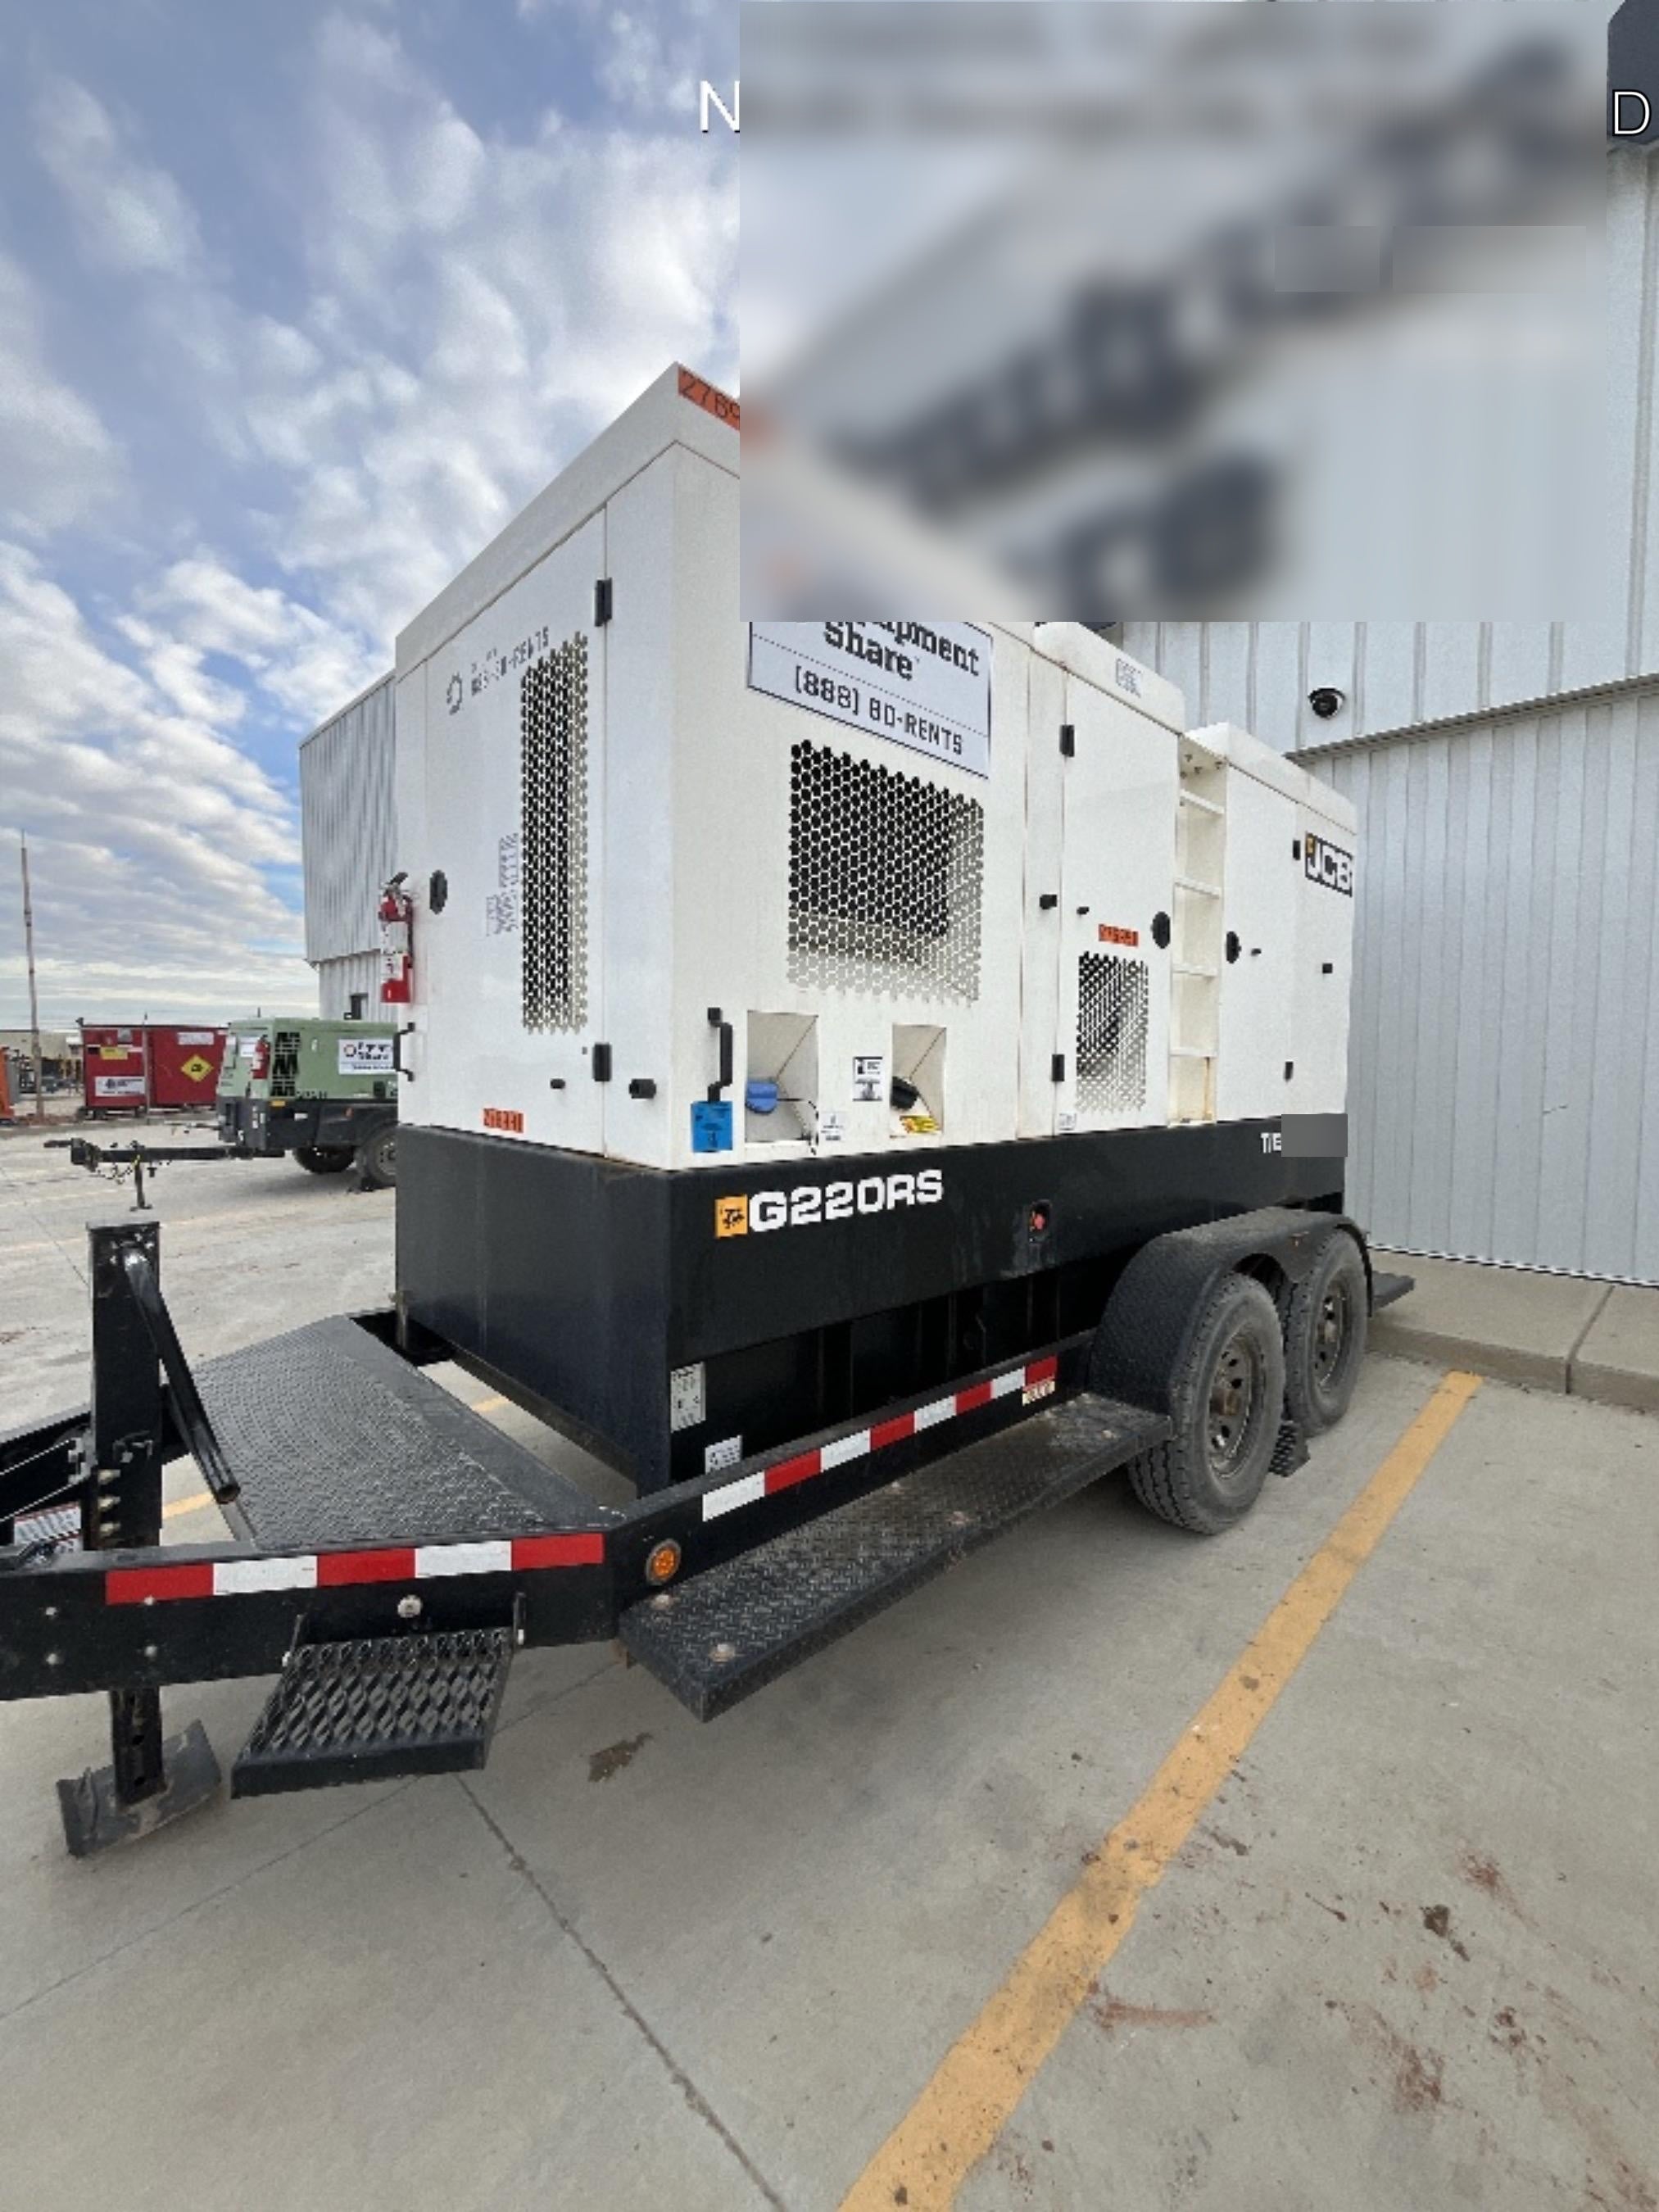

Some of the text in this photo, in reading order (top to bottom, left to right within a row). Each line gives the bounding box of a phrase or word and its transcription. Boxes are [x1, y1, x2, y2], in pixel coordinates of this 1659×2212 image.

[824, 621, 913, 681] Share
[1306, 837, 1353, 893] JCB
[1260, 1132, 1281, 1154] TIE
[749, 1169, 944, 1232] G220RS
